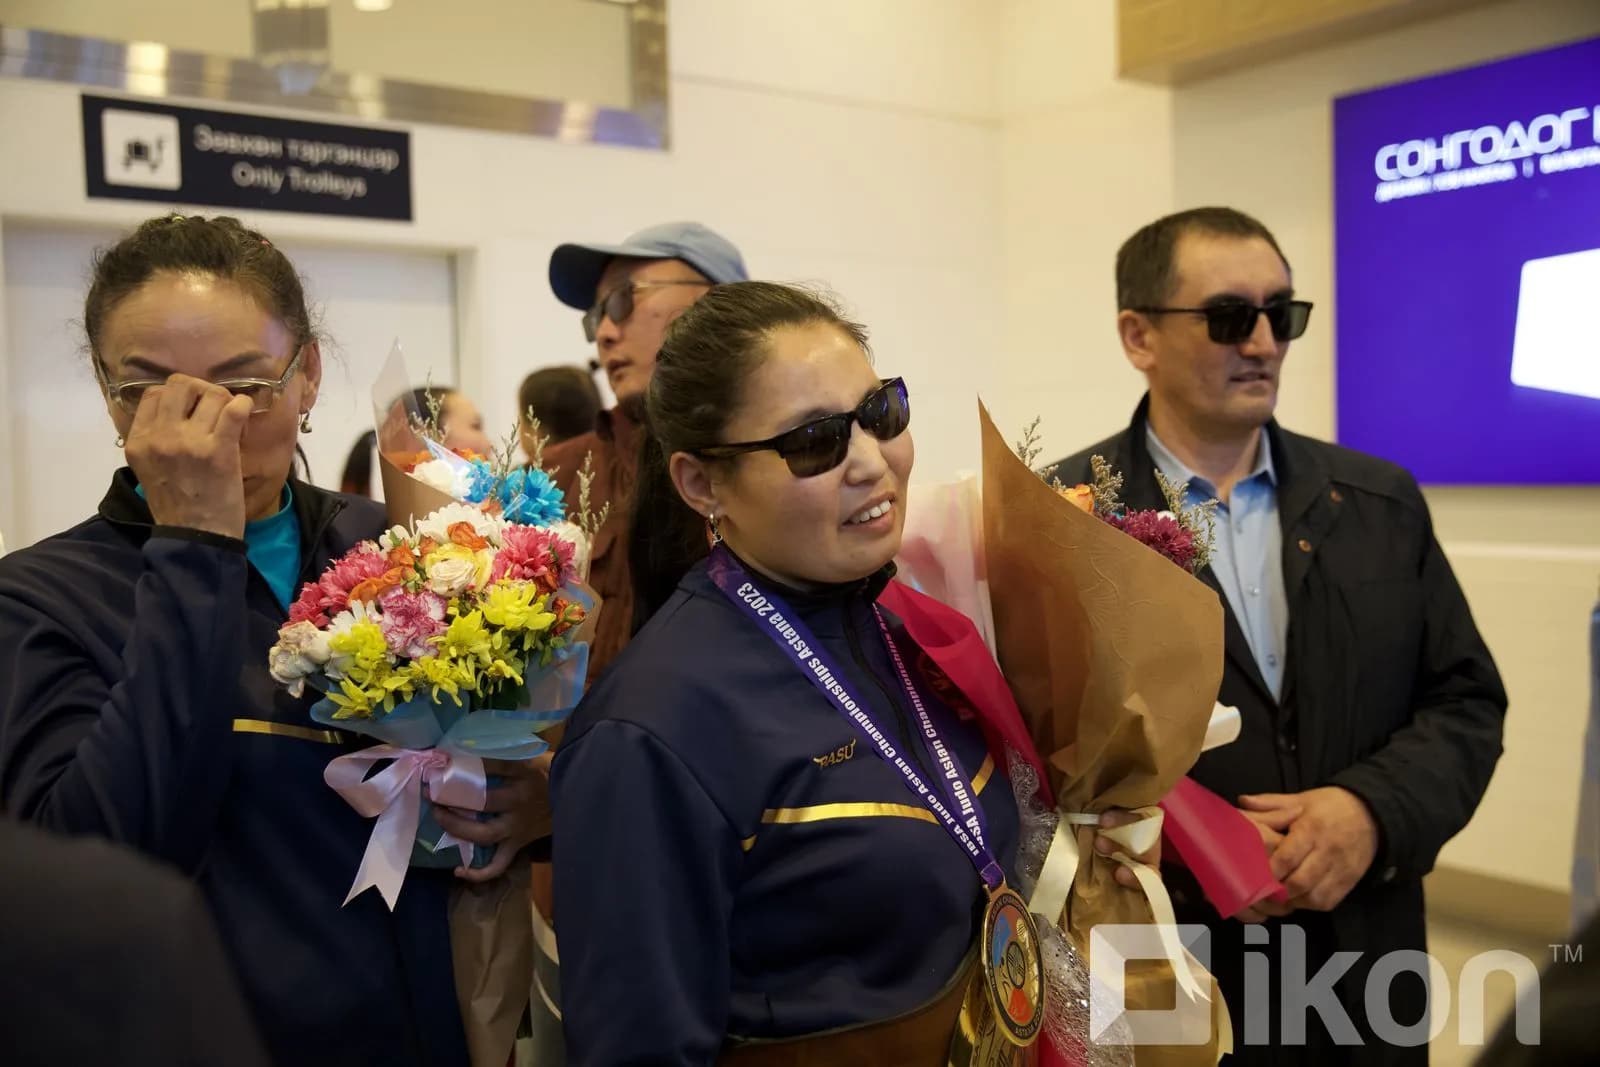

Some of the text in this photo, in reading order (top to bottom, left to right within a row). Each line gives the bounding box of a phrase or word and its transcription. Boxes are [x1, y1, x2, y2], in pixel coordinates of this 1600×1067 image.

[1375, 106, 1590, 182] СОНГОДОГ
[231, 161, 368, 200] Only Trolleys
[736, 582, 775, 617] 2023
[768, 612, 814, 660] Astana
[808, 657, 897, 759] Championships
[894, 757, 929, 794] Asian
[932, 739, 959, 780] Asian
[927, 794, 956, 825] Judo
[952, 780, 975, 816] Judo
[953, 825, 980, 856] IBSA
